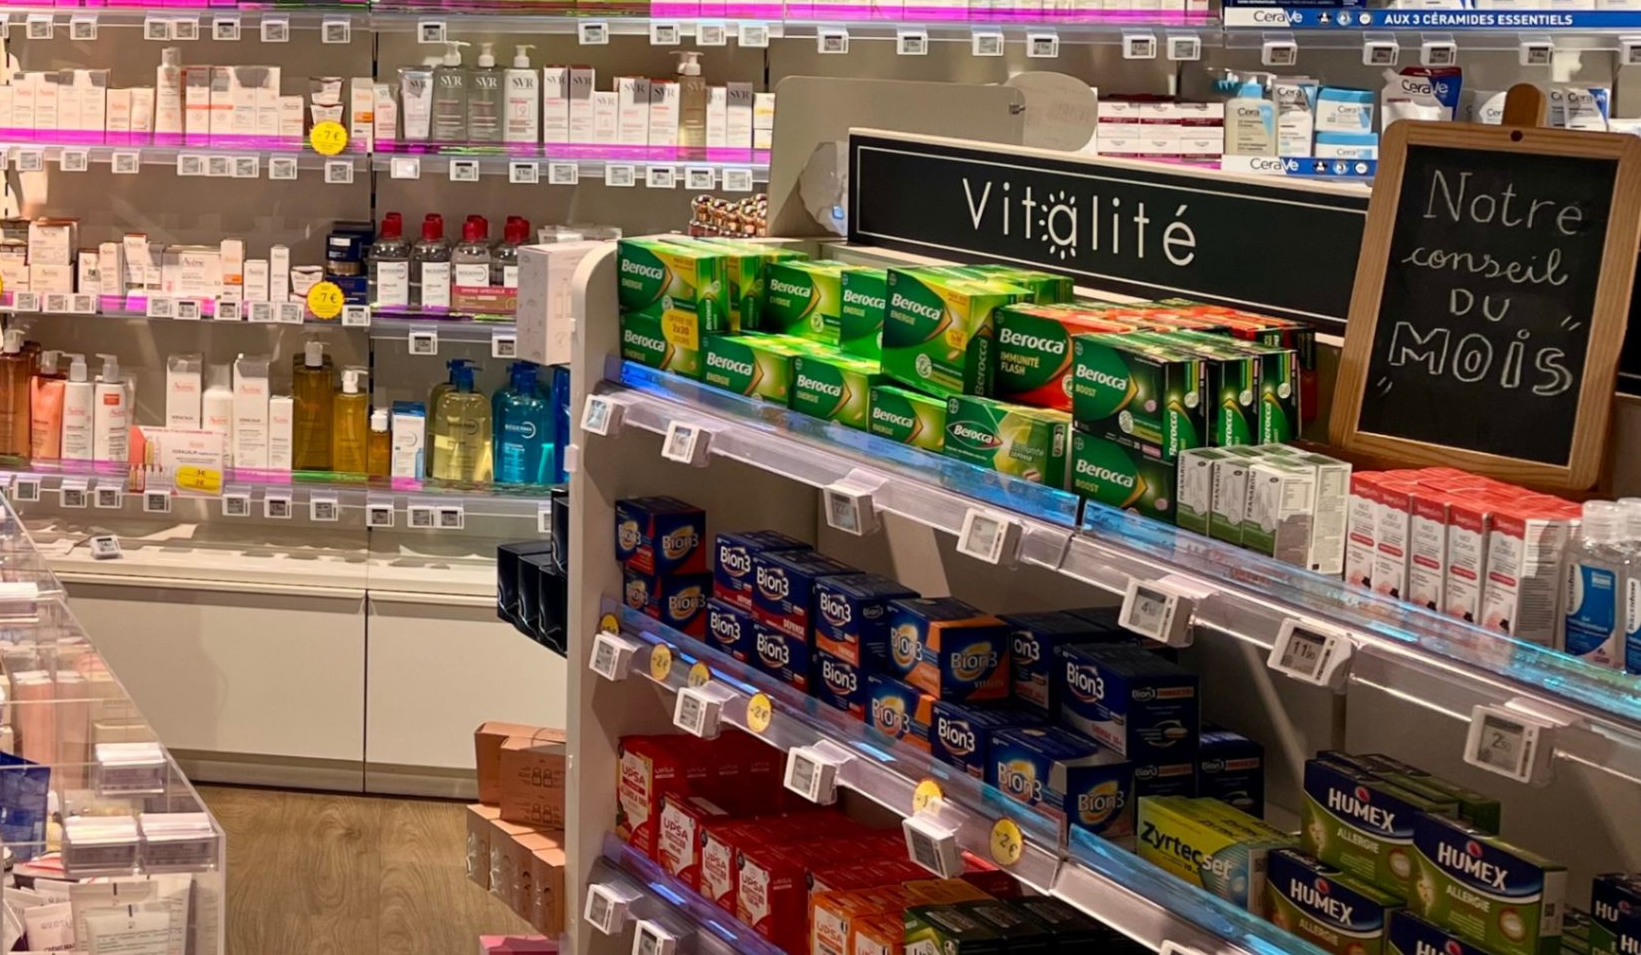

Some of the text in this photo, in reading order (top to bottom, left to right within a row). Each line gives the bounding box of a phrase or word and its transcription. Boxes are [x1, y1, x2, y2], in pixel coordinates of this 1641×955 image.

[1253, 10, 1303, 24] CeraVe
[1384, 11, 1573, 25] AUX 3 CÉRAMIDES ESSENTIELS
[1250, 157, 1298, 173] CeraVe
[1423, 169, 1583, 235] Notre
[961, 177, 1197, 267] Vitalité
[621, 258, 663, 280] Berocca
[1401, 246, 1569, 285] conseil
[770, 278, 811, 298] Berocca
[891, 292, 941, 321] Berocca
[1450, 288, 1510, 322] DU
[624, 328, 665, 352] Berocca
[1000, 327, 1065, 354] Berocca
[706, 351, 753, 376] Berocca
[1000, 352, 1040, 368] IMMUNITÉ
[1001, 362, 1026, 376] FLASH
[797, 373, 841, 398] Berocca
[1075, 383, 1097, 397] BOOST
[1076, 364, 1128, 391] Berocca
[872, 407, 913, 428] Berocca
[953, 424, 993, 444] Berocca
[1075, 458, 1135, 488] Berocca
[1075, 478, 1100, 494] BOOST
[720, 545, 751, 571] Bion3
[756, 567, 789, 597] Bion3
[820, 594, 851, 624] Bion3
[711, 613, 741, 641] Bion3
[756, 635, 789, 666] Bion3
[823, 660, 857, 692] Bion3
[1067, 661, 1104, 700] Bion3
[938, 717, 975, 752] Bion3
[622, 764, 646, 786] UPSA
[1328, 786, 1397, 834] HUMEX
[663, 818, 688, 841] UPSA
[1337, 827, 1380, 854] ALLERGIE
[1438, 841, 1509, 892] HUMEX
[1290, 877, 1354, 926] HUMEX
[1446, 883, 1491, 913] ALLERGIE
[1299, 918, 1339, 946] ALLERGIE
